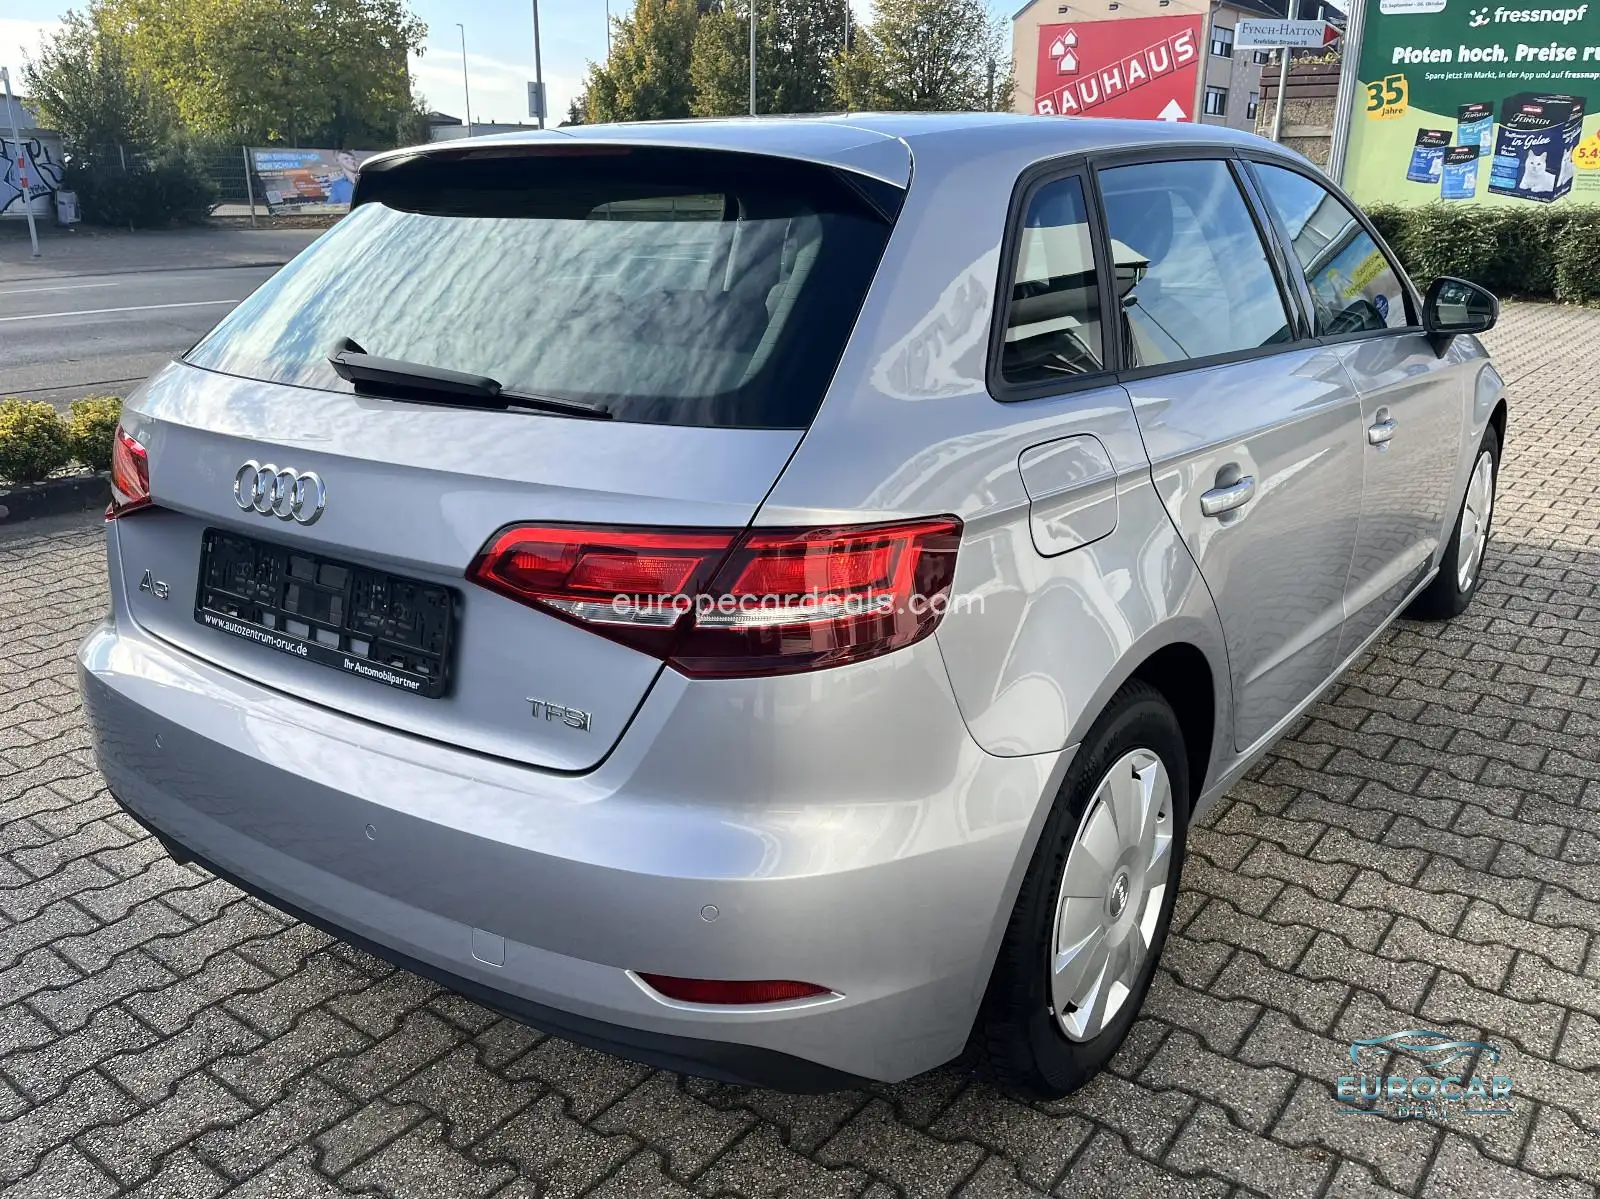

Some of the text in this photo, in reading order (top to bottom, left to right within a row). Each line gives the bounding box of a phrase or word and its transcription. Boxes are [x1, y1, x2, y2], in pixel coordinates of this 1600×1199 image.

[1494, 4, 1588, 25] fressnapf
[1392, 46, 1452, 64] Pfoten
[1457, 44, 1508, 63] hoch,
[1515, 42, 1577, 63] Preise
[1037, 32, 1195, 115] BAUHAUS
[1424, 72, 1445, 80] Spare
[1474, 71, 1497, 79] Markt,
[1519, 71, 1535, 81] App
[1536, 70, 1550, 79] und
[1551, 70, 1564, 79] auf
[1367, 76, 1403, 111] 35
[1578, 148, 1600, 158] 5.4
[138, 568, 170, 601] A3
[204, 614, 308, 656] www.autozentrum-oruc.de
[344, 658, 420, 690] Ihr Automobilpartner
[525, 696, 593, 733] TFSI
